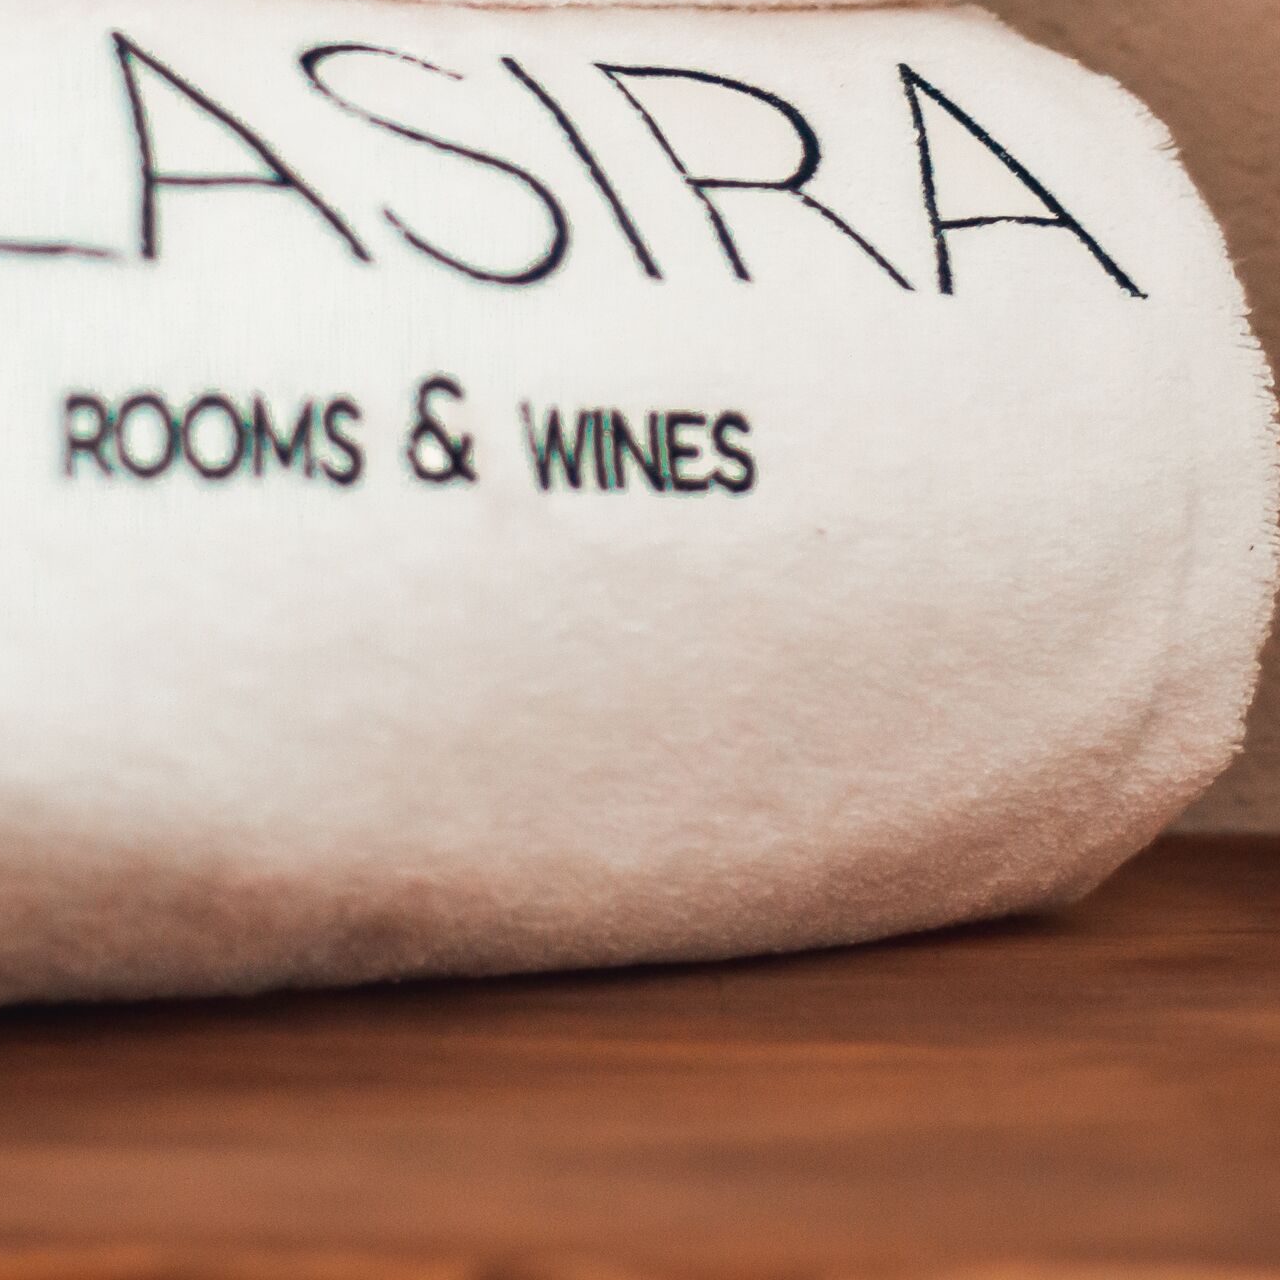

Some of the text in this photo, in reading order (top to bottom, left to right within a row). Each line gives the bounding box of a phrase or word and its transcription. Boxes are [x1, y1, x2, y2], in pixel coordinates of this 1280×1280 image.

[60, 372, 760, 497] ROOMS & WINES
